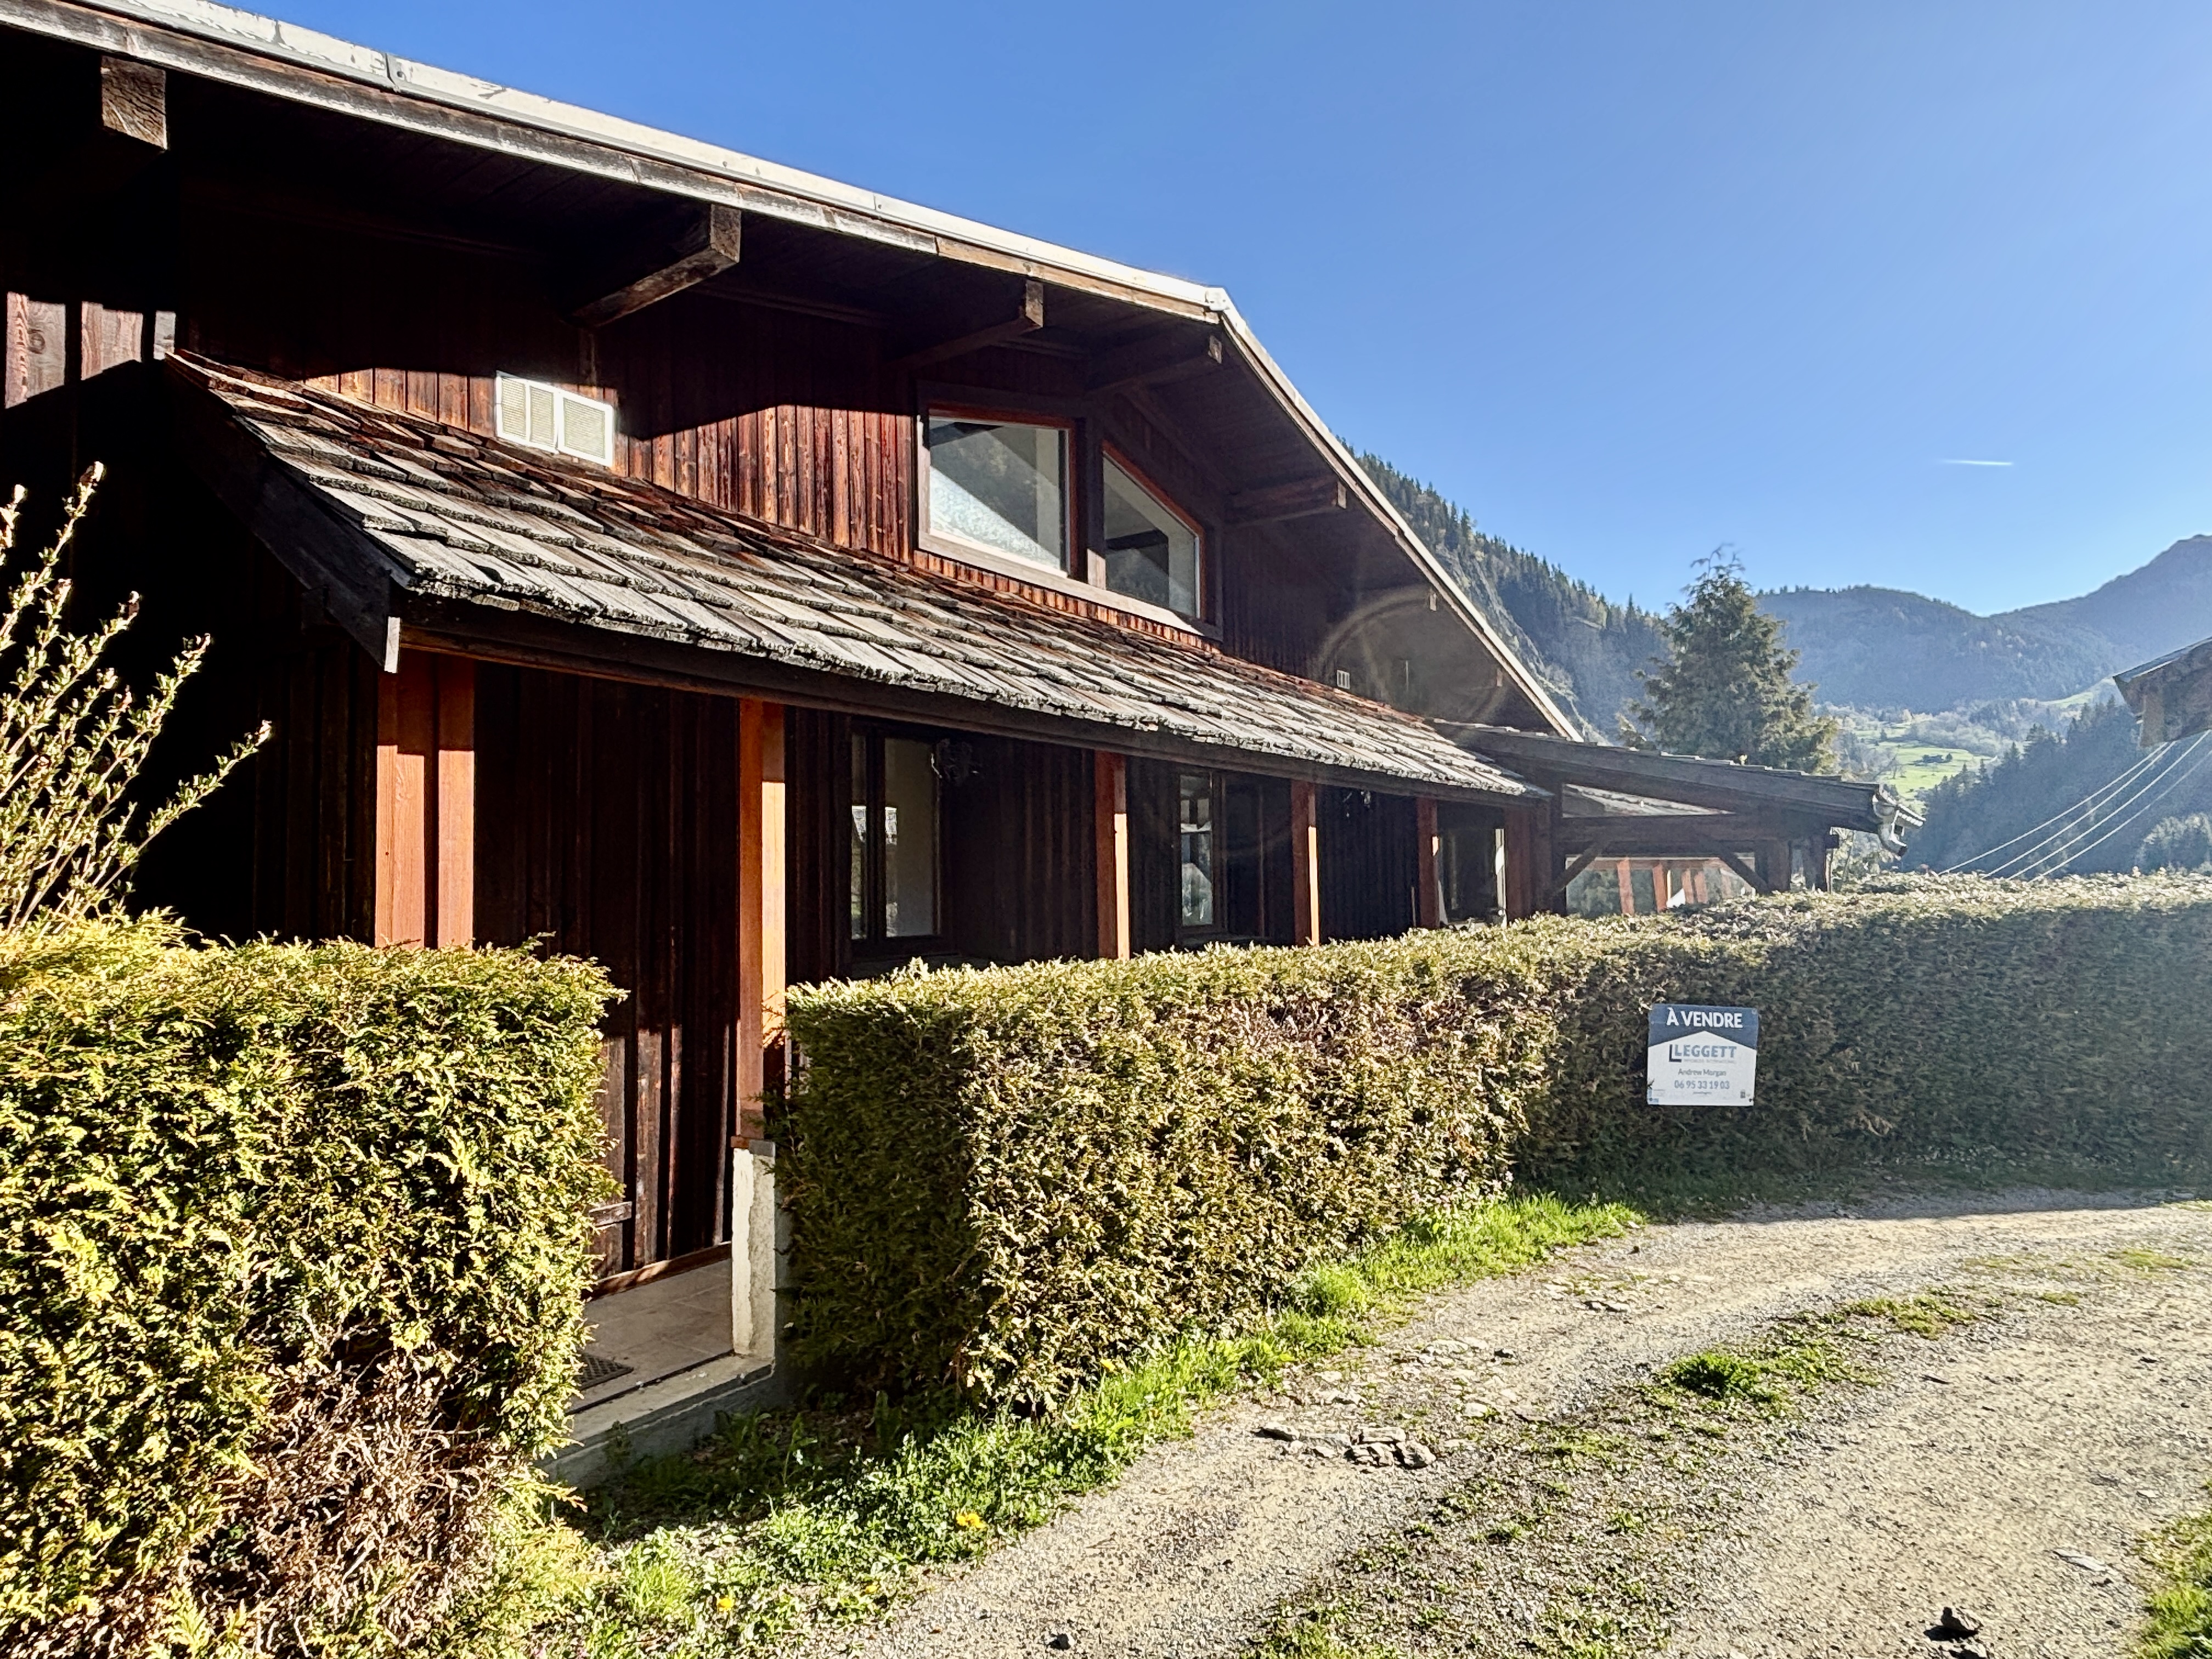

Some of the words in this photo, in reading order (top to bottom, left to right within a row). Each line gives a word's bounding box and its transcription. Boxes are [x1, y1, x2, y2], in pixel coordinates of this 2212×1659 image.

[1667, 1007, 1679, 1026] À
[1680, 1011, 1743, 1028] VENDRE
[1674, 1044, 1737, 1058] LEGGETT
[1703, 1069, 1726, 1077] Morgan
[1697, 1081, 1707, 1089] 33
[1709, 1081, 1718, 1089] 19
[1720, 1081, 1730, 1090] 03
